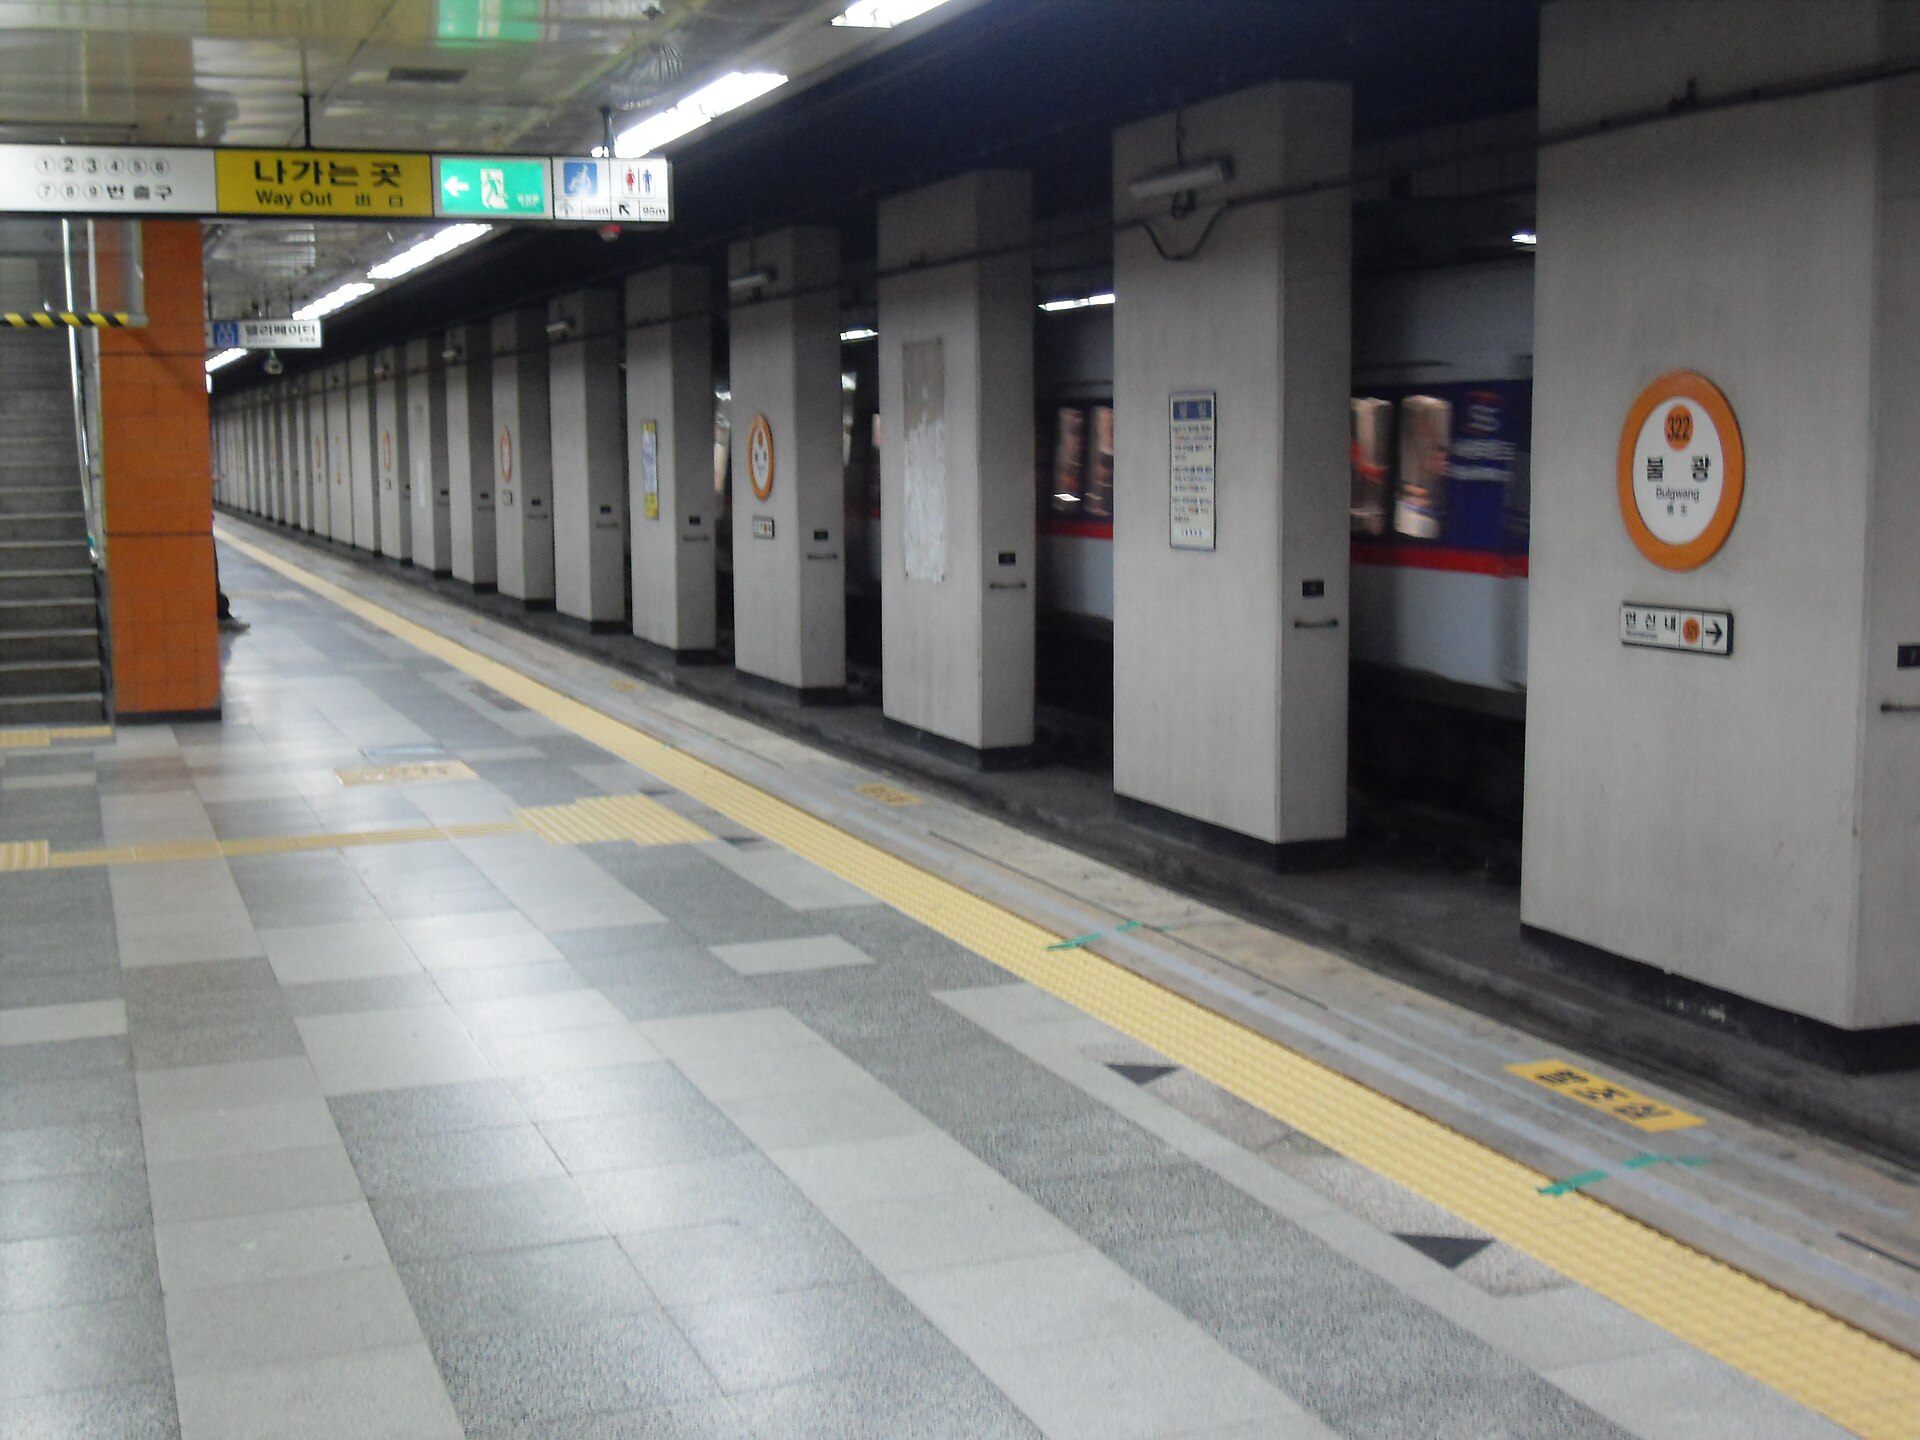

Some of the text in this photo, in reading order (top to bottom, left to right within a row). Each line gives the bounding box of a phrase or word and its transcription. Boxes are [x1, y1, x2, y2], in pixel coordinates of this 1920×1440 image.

[256, 189, 333, 208] Way Out
[1667, 415, 1690, 440] 322
[1656, 486, 1700, 502] Bulgwang
